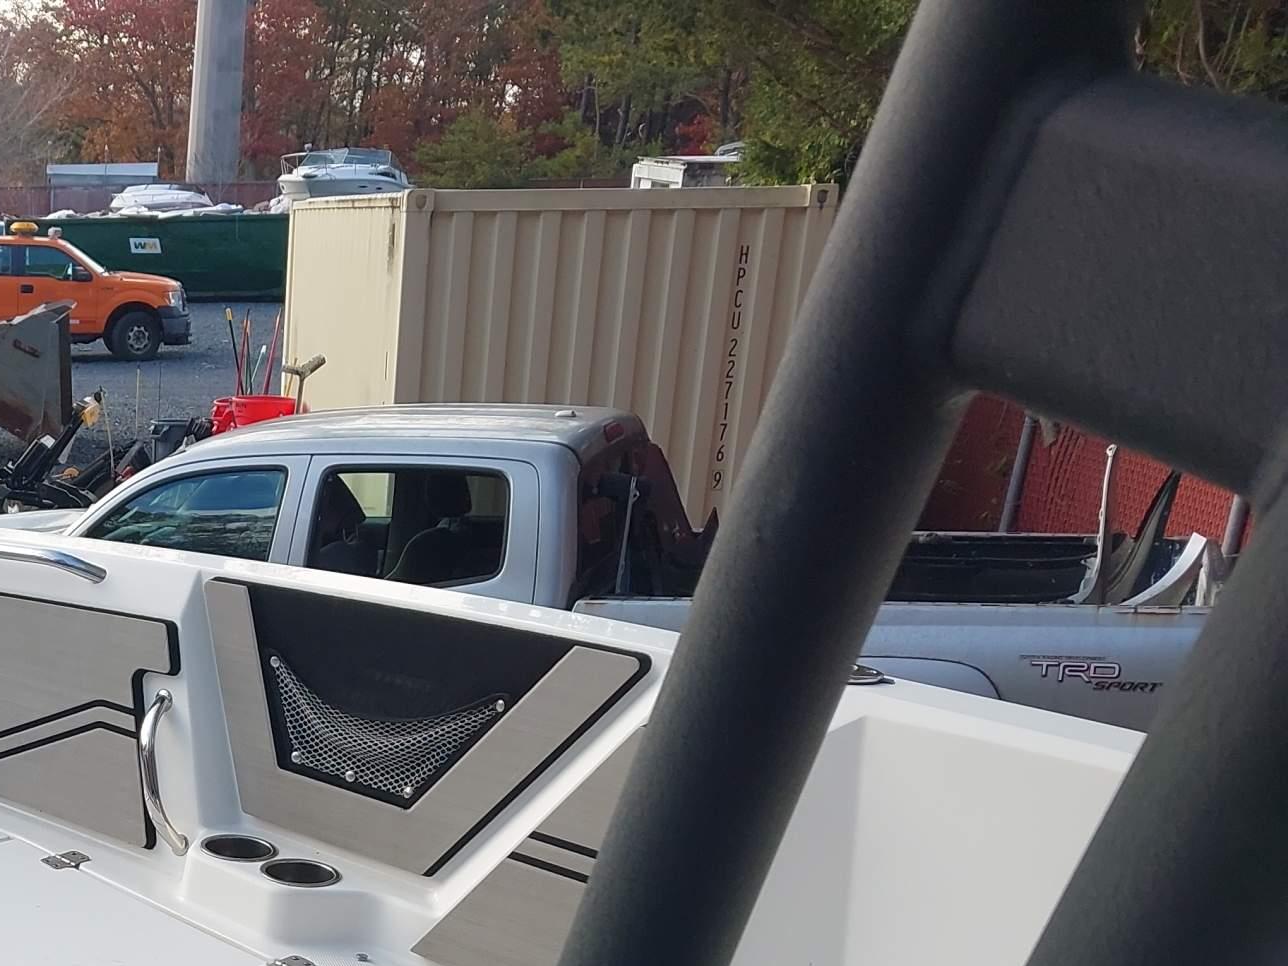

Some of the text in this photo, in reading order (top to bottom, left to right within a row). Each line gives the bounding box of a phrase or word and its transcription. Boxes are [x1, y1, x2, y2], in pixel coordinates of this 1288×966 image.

[134, 241, 158, 250] WM
[731, 245, 750, 330] HPCU
[1031, 660, 1122, 683] TRD
[1093, 680, 1164, 693] SPORT
